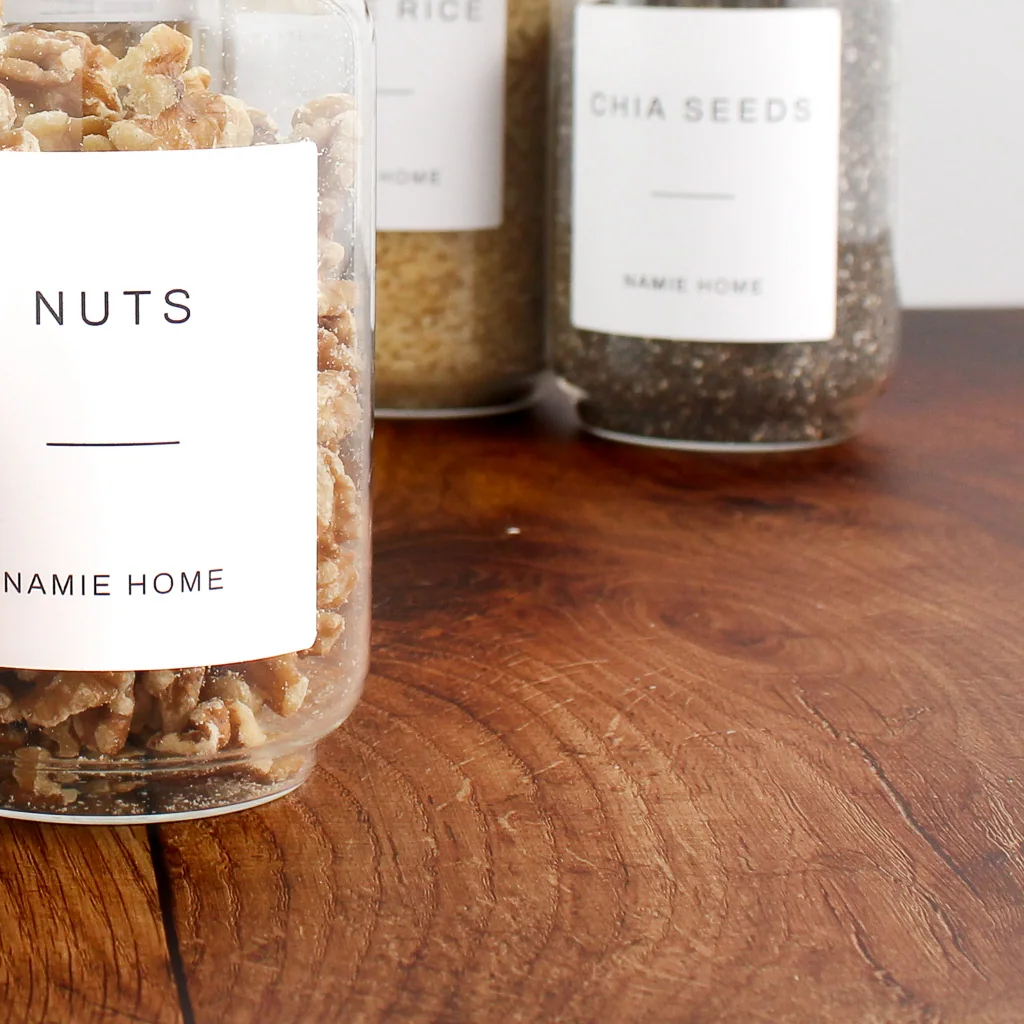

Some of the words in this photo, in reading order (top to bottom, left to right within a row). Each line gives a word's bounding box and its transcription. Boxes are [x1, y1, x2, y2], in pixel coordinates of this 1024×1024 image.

[589, 91, 667, 121] CHIA
[682, 96, 813, 124] SEEDS
[623, 272, 688, 294] NAMIE
[696, 277, 764, 297] HOME
[34, 288, 192, 326] NUTS
[4, 571, 111, 596] NAMIE
[128, 568, 224, 596] HOME
